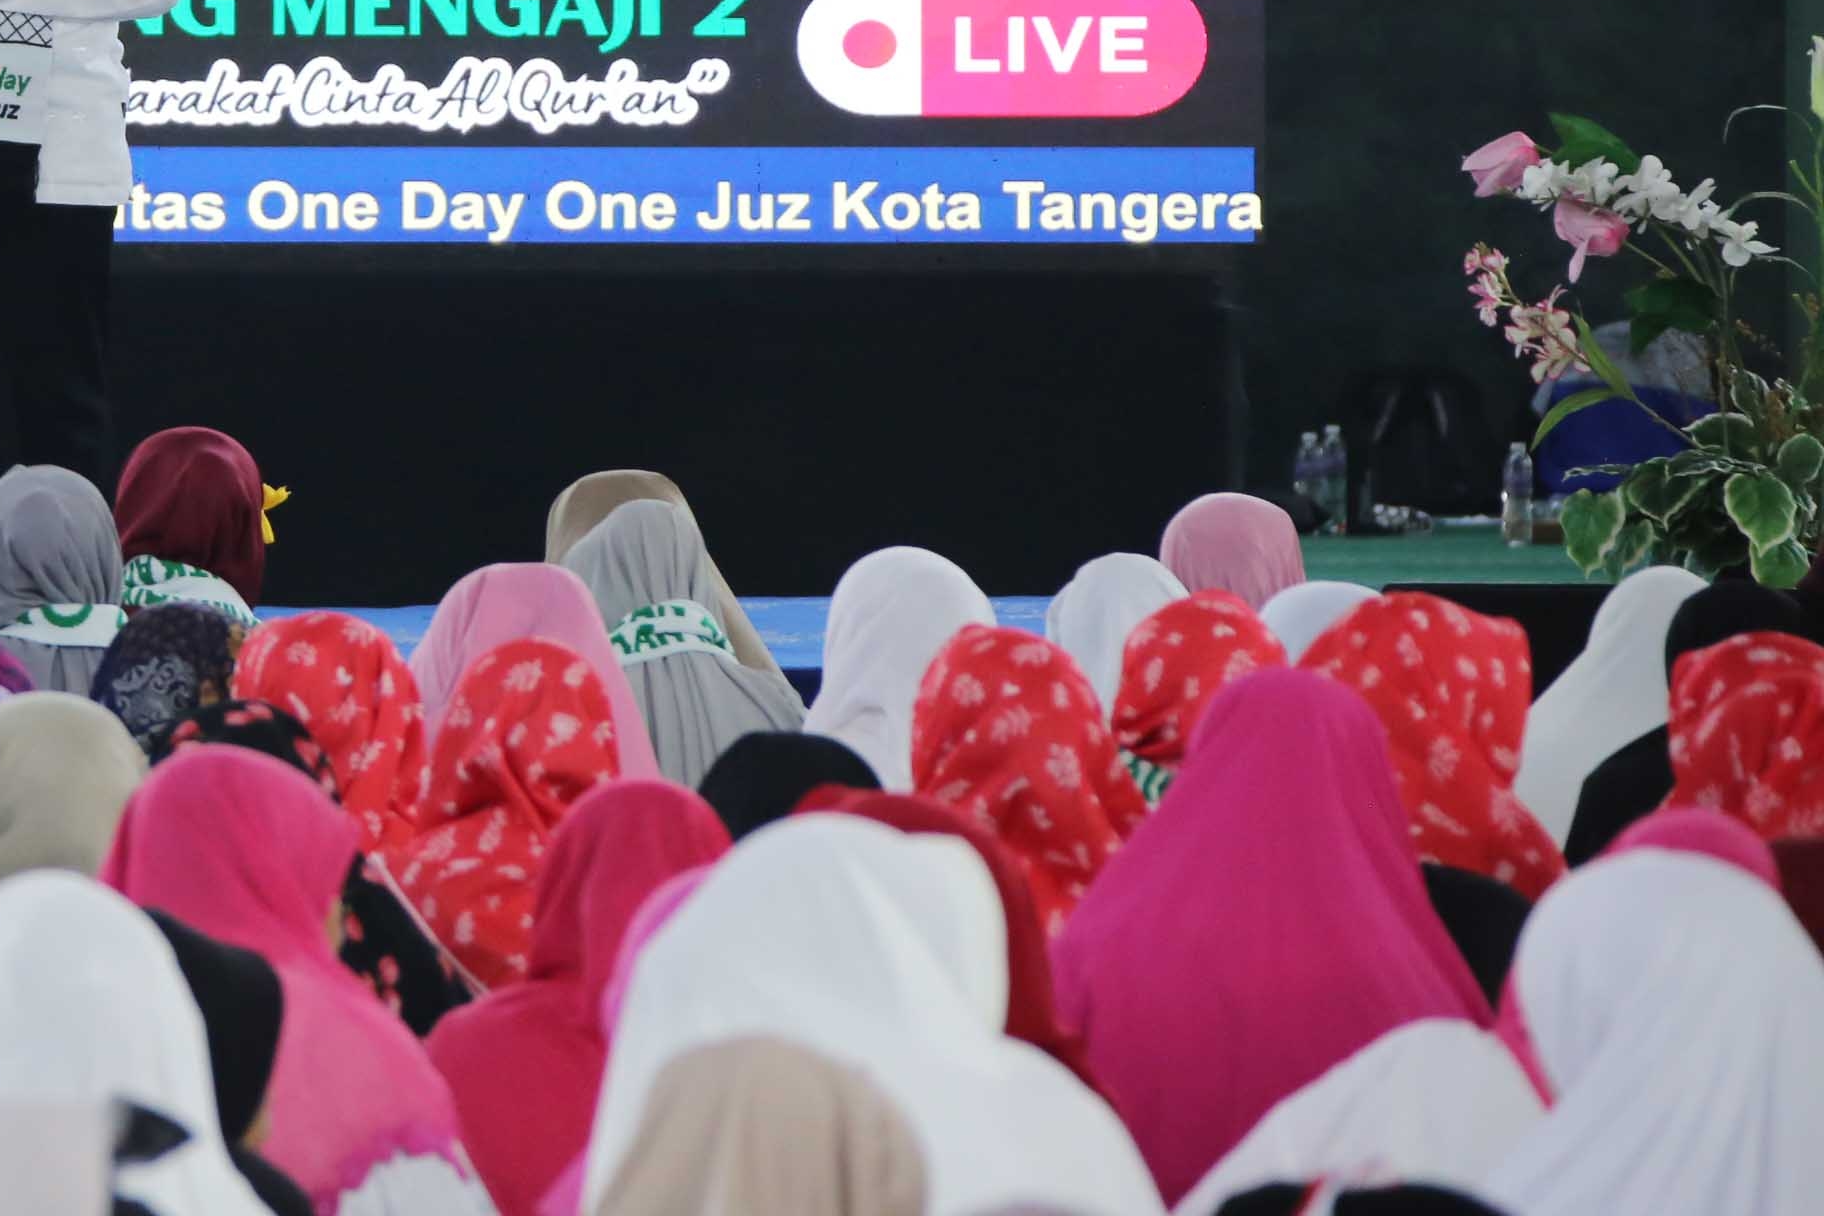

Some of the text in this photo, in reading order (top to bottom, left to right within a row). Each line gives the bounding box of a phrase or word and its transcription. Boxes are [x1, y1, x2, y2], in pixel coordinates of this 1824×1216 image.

[954, 16, 1149, 73] LIVE
[127, 70, 286, 115] arakat
[301, 68, 424, 116] Cinta
[428, 68, 501, 120] Al
[247, 180, 379, 231] One
[401, 181, 525, 243] Day
[545, 180, 677, 231] One
[695, 181, 811, 231] Juz
[832, 181, 980, 231] Kota
[1002, 181, 1263, 243] Tangera
